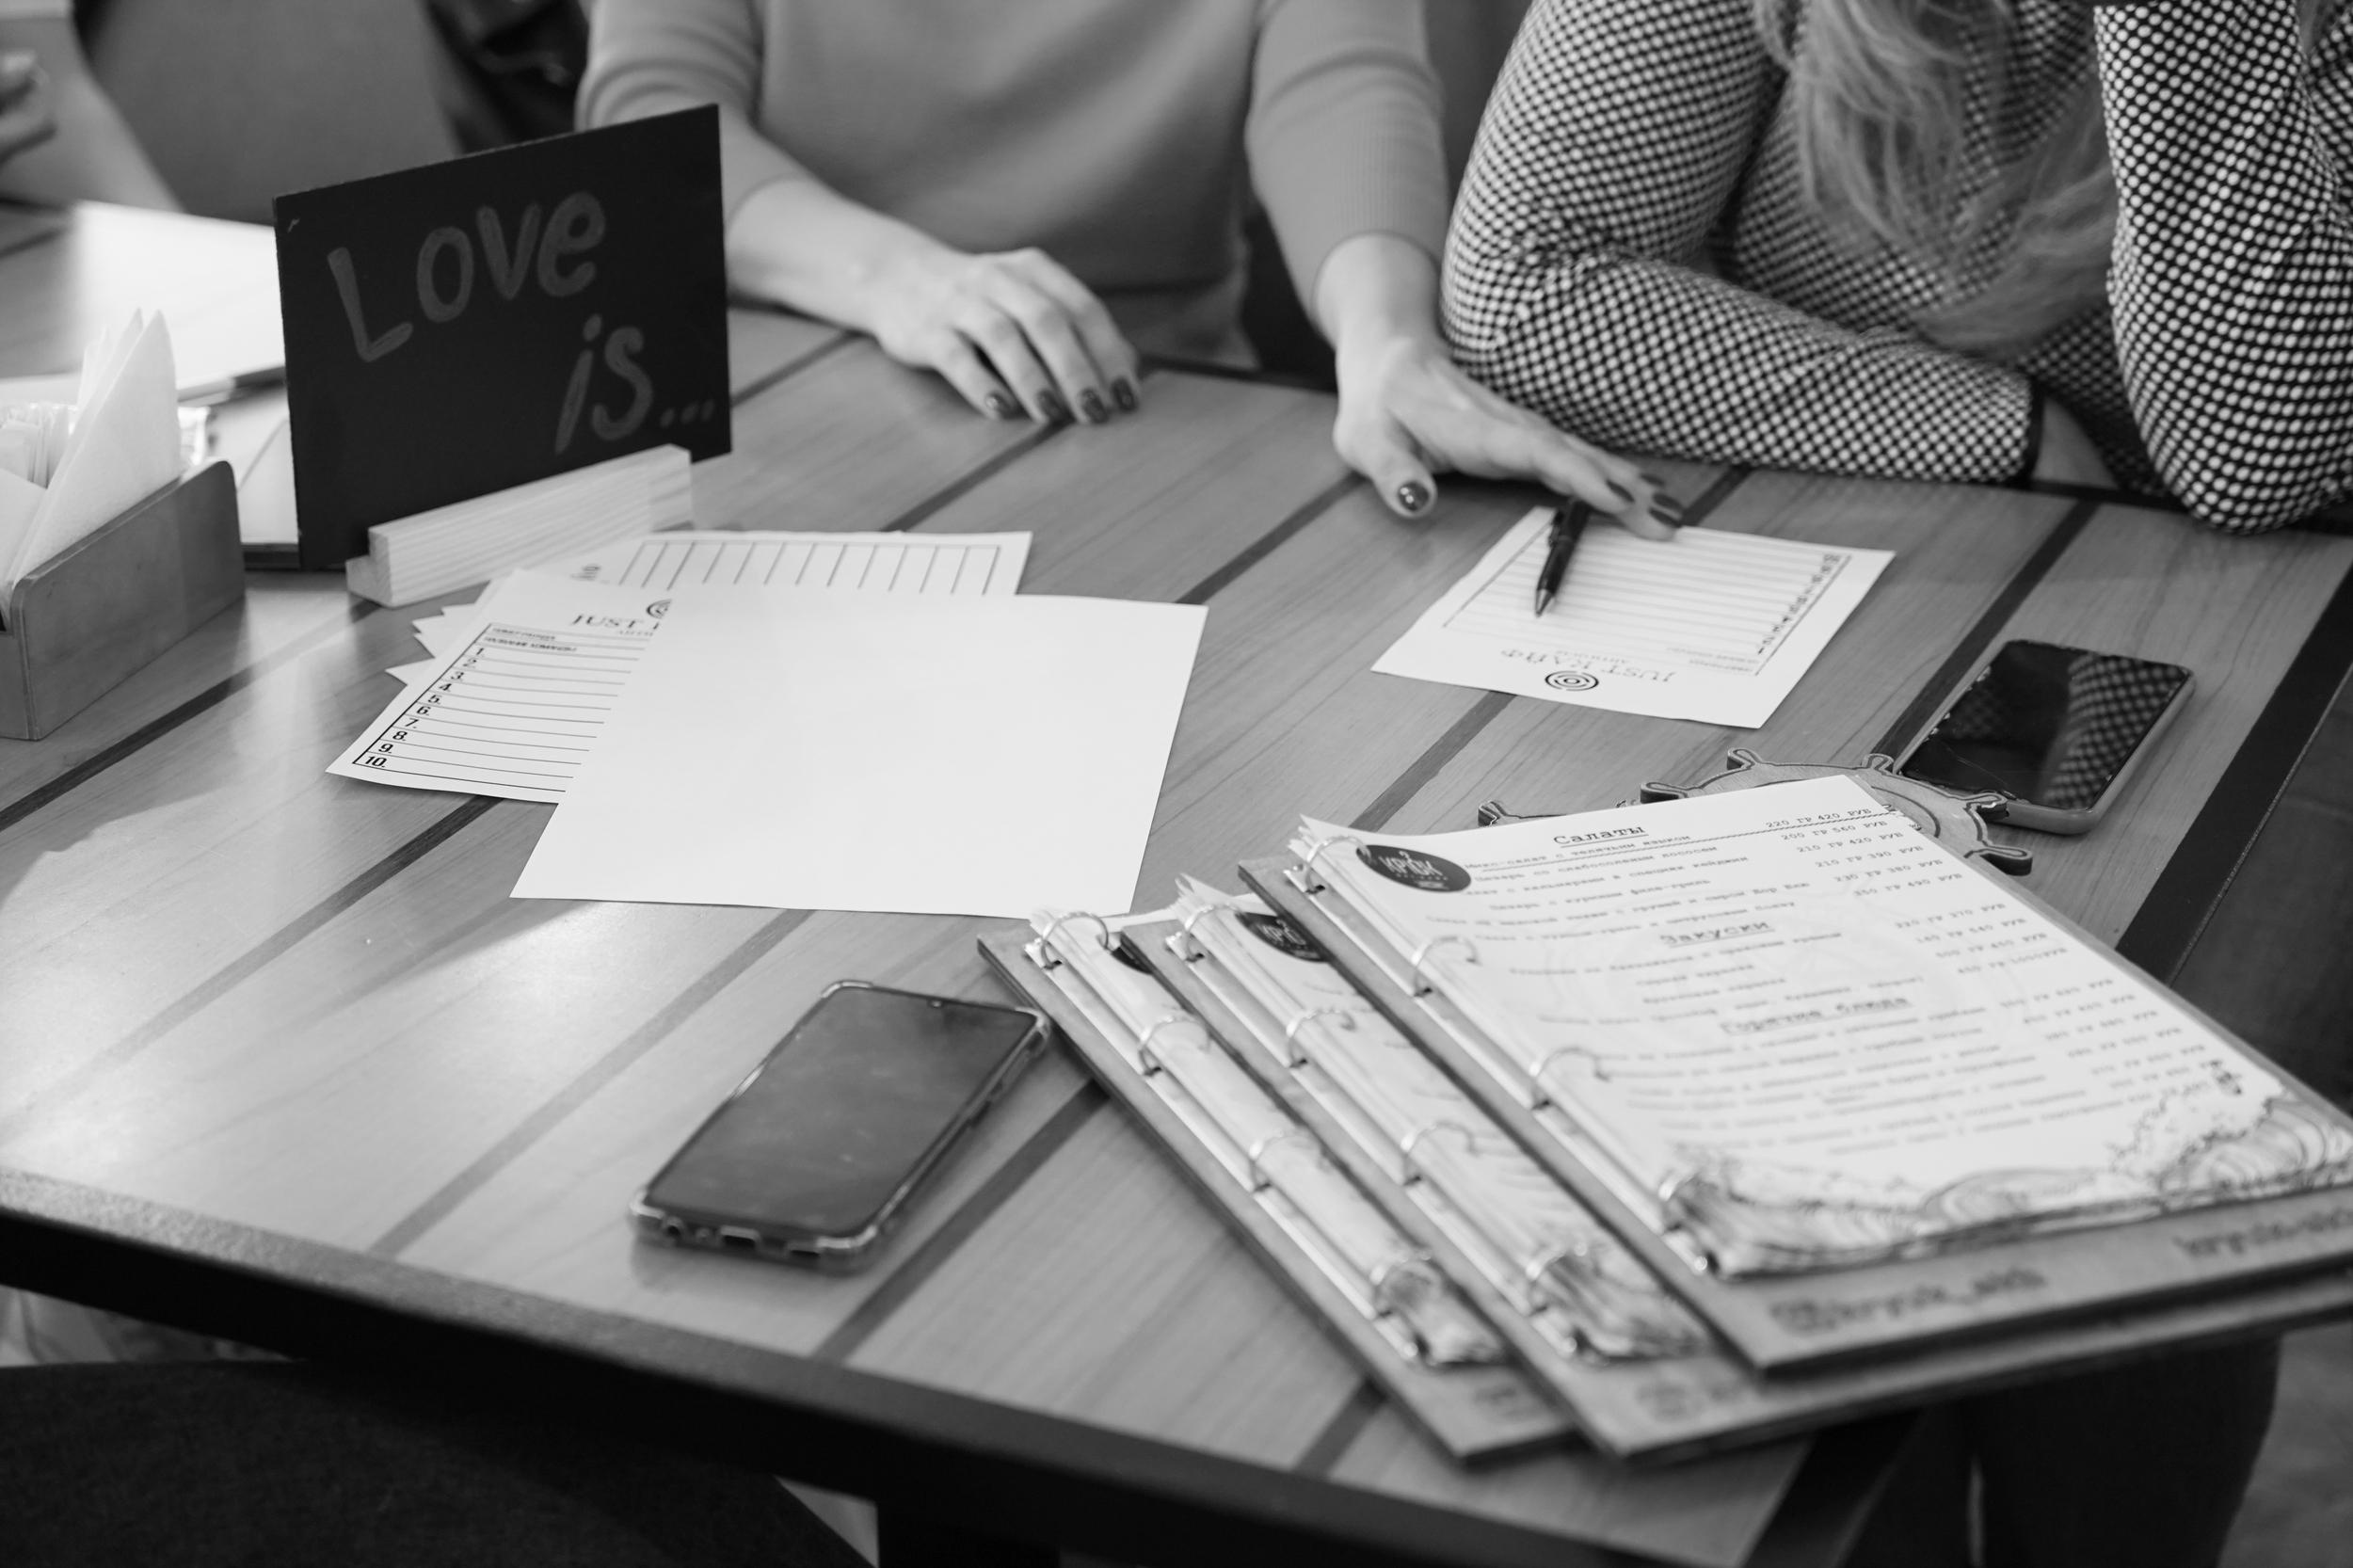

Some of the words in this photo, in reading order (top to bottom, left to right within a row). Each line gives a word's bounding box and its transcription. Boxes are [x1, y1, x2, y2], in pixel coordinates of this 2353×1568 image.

[327, 191, 606, 362] Love
[570, 615, 644, 628] JUST
[462, 659, 477, 669] 2.
[451, 671, 464, 681] 3.
[439, 683, 453, 694] 4.
[427, 695, 441, 705] 5.
[416, 707, 430, 717] 6.
[405, 718, 418, 729] 7.
[392, 730, 407, 742] 8.
[378, 744, 392, 754] 9.
[364, 756, 386, 768] 10.
[1765, 820, 1789, 828] 220
[1817, 812, 1841, 822] 420
[1847, 808, 1872, 817] РУБ
[1863, 820, 1889, 829] РУБ
[1553, 826, 1646, 845] Салаты
[1849, 837, 1873, 845] 420
[1879, 831, 1904, 840] РУБ
[1898, 845, 1924, 855] РУБ
[1916, 858, 1944, 869] РУБ
[1659, 921, 1769, 944] Закуски
